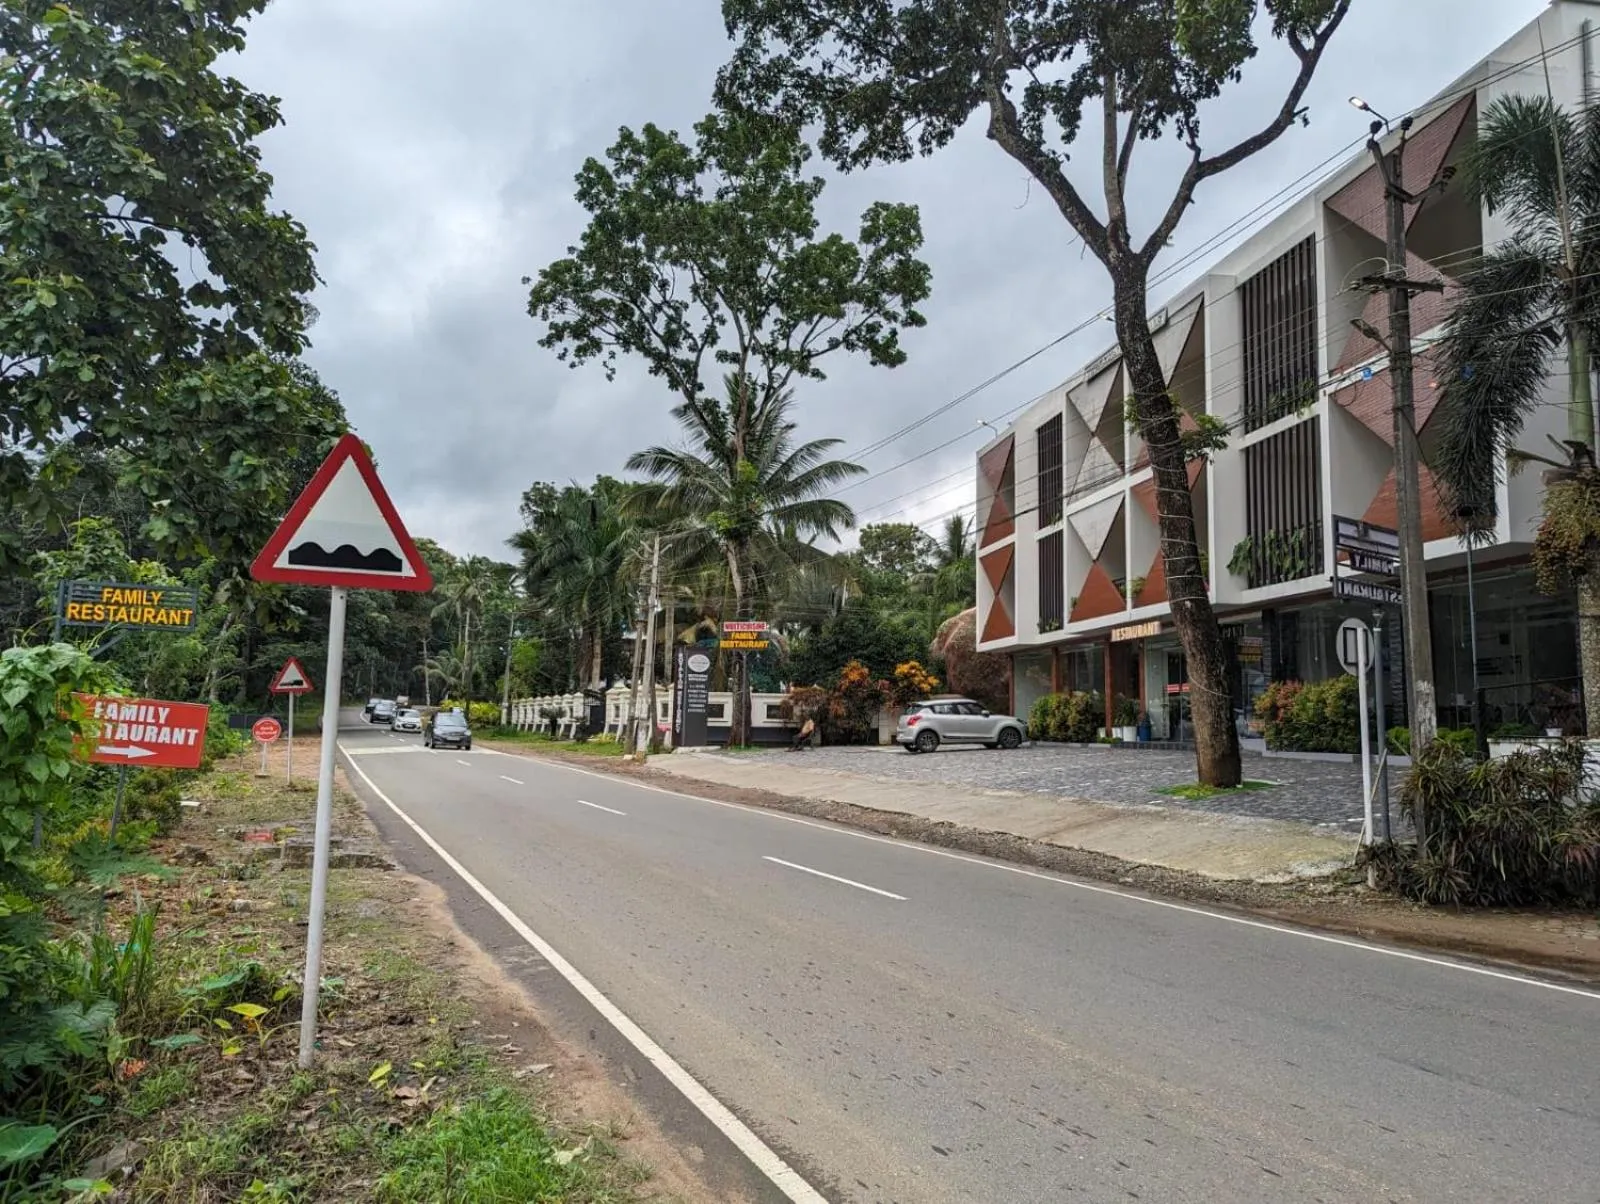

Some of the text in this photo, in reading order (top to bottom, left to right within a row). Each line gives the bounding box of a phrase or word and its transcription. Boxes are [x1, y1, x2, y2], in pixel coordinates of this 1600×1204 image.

[102, 588, 164, 606] FAMILY
[67, 604, 193, 625] RESTAURANT
[94, 701, 170, 724] FAMILY
